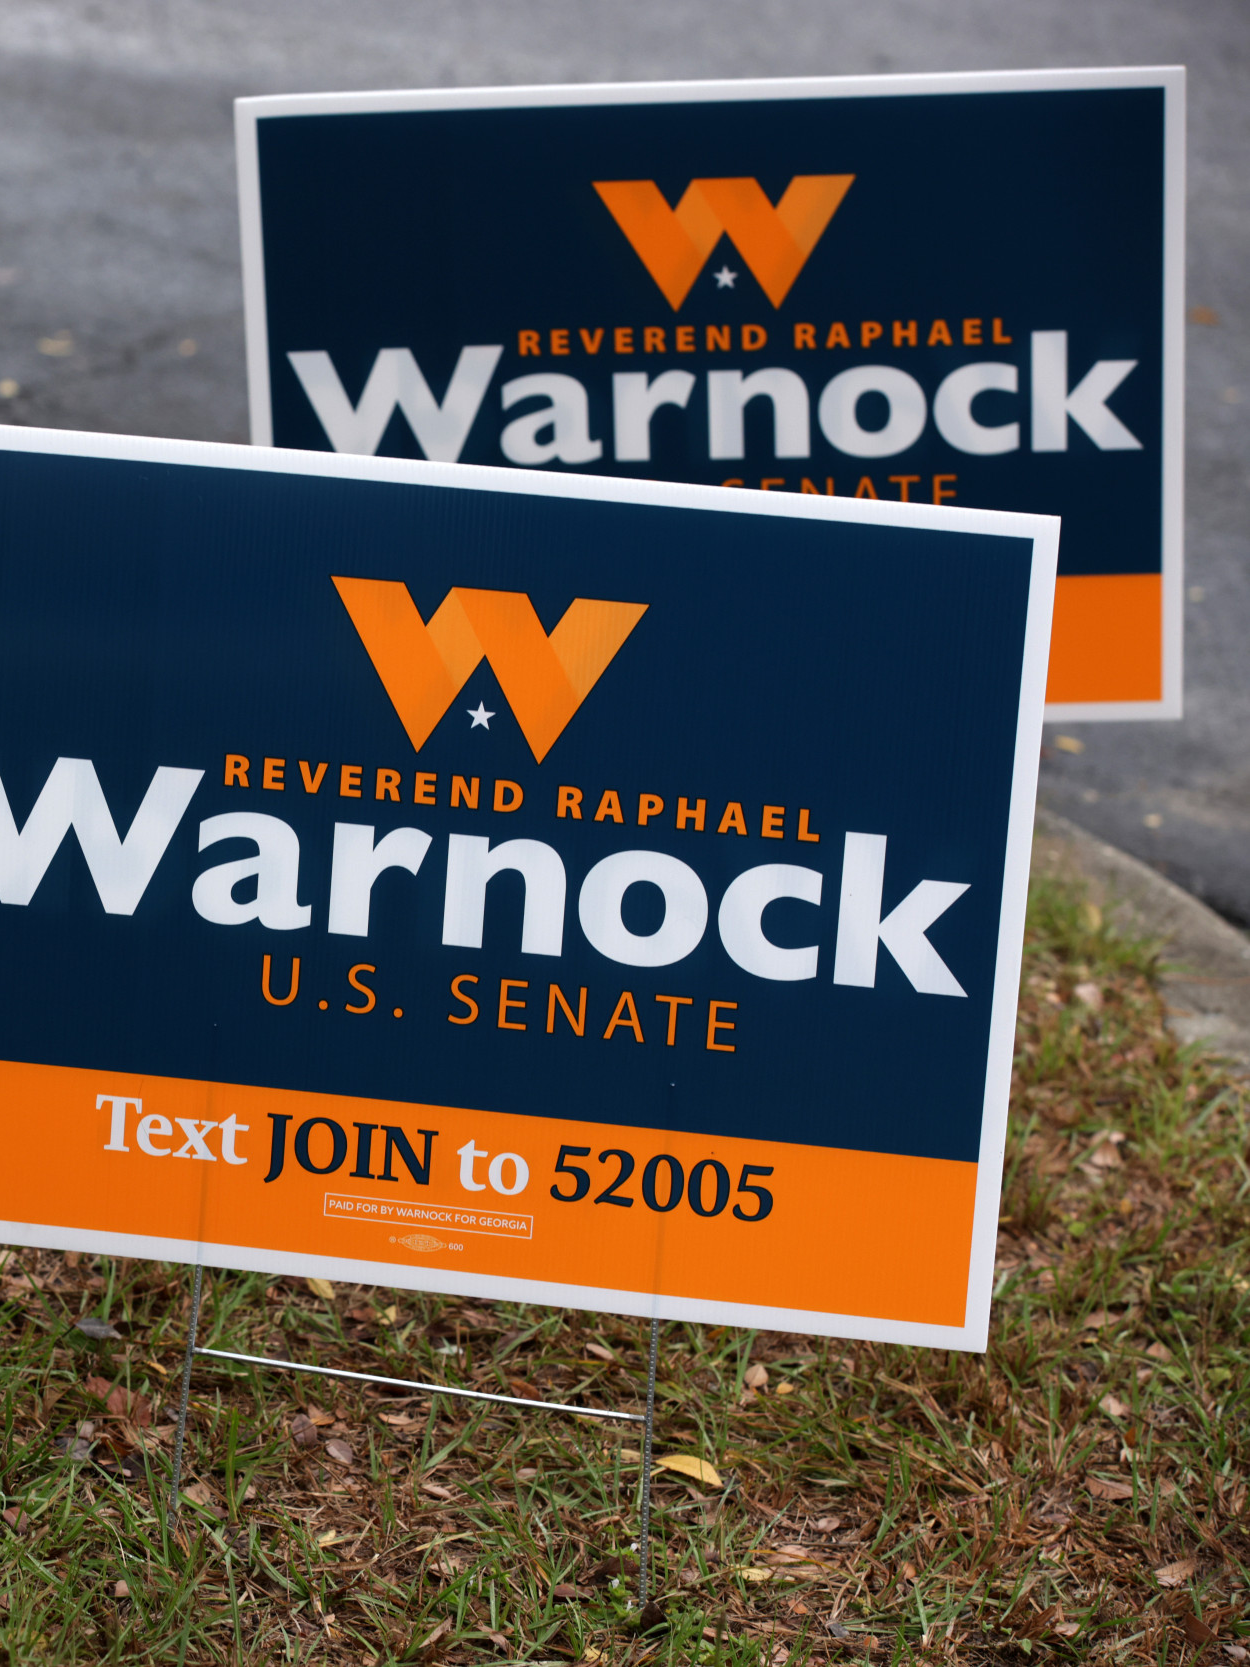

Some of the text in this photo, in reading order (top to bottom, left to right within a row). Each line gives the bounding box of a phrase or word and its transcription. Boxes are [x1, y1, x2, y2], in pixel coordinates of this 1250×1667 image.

[517, 317, 1013, 356] REVEREND RAPHAEL
[287, 330, 1144, 465] Warnock
[720, 474, 958, 506] ATE
[223, 753, 822, 843] REVEREND RAPHAEL
[260, 954, 739, 1053] U.S. SENATE
[95, 1093, 776, 1222] Text JOIN to 52005
[329, 1199, 528, 1231] PAID FOR BY WARNOCK FOR GEORGIA
